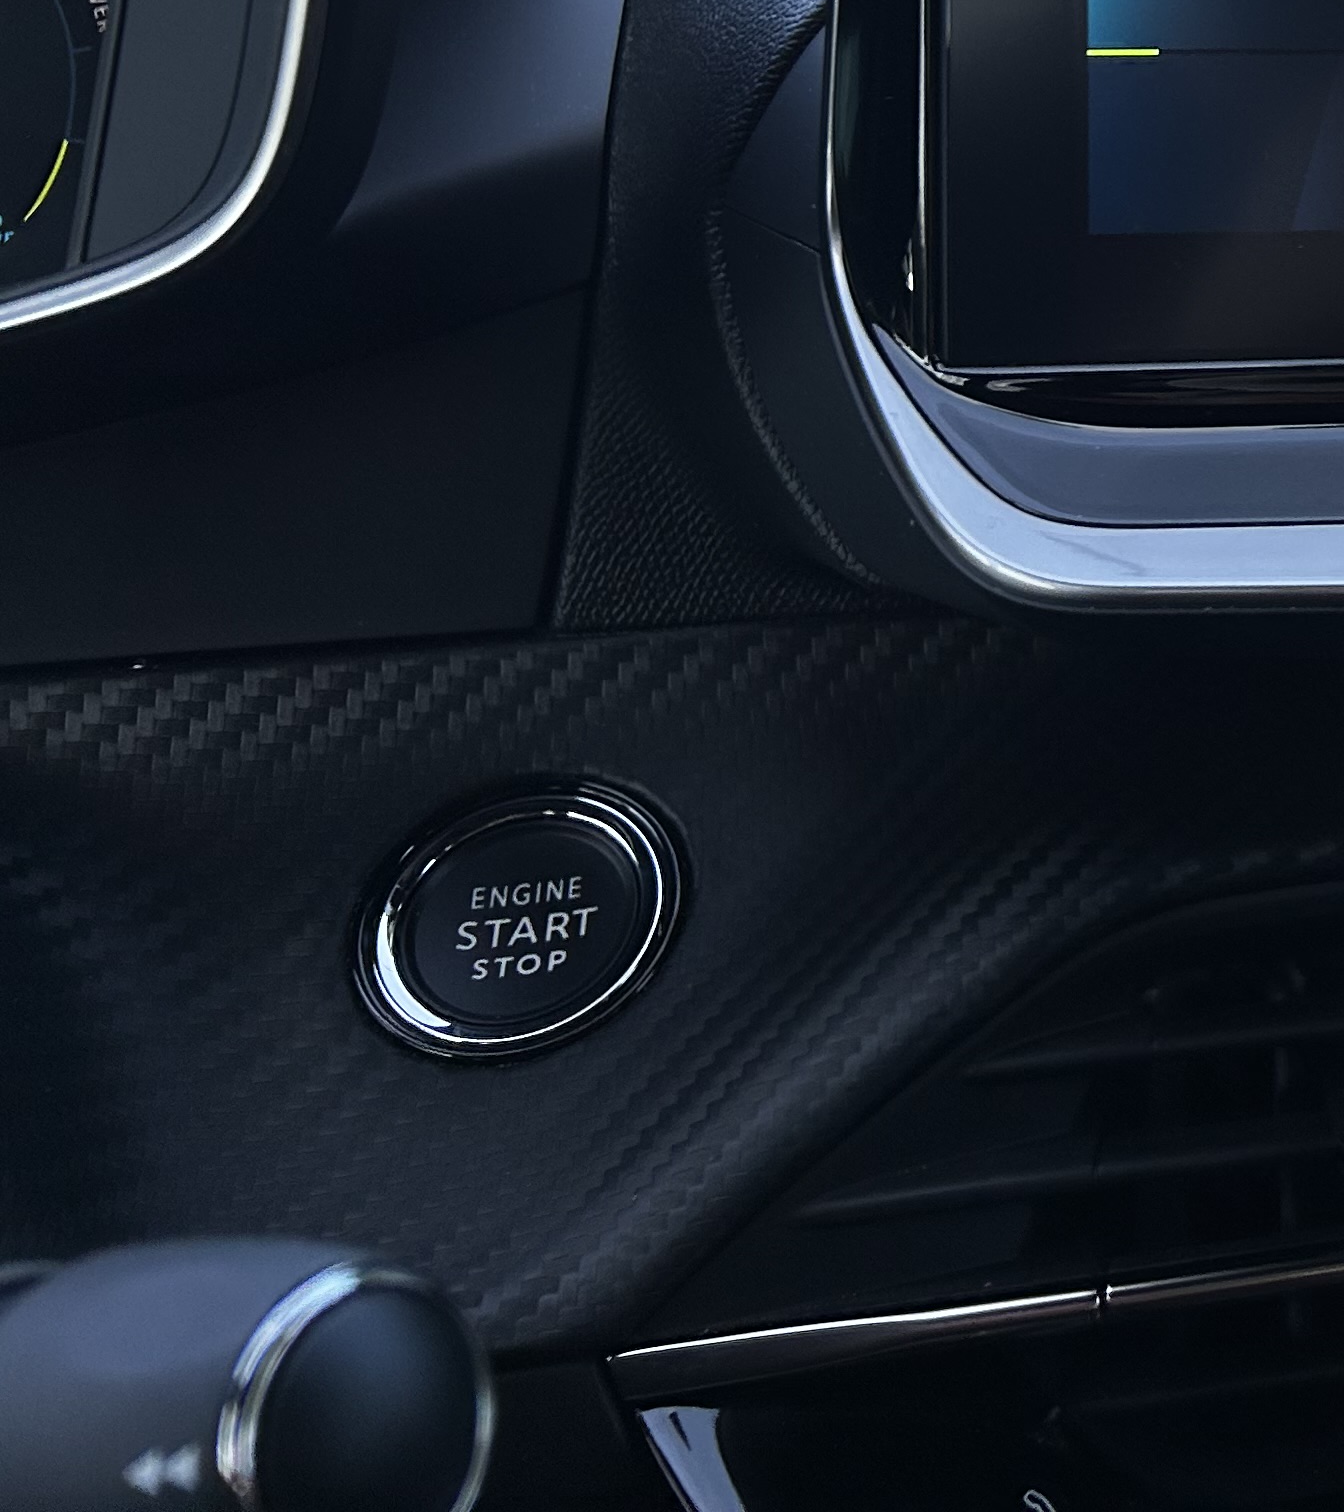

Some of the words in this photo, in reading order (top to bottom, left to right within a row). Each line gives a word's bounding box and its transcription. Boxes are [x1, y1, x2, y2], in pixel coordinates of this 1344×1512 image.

[470, 876, 584, 911] ENGINE
[455, 905, 599, 952] START
[471, 949, 568, 981] STOP
